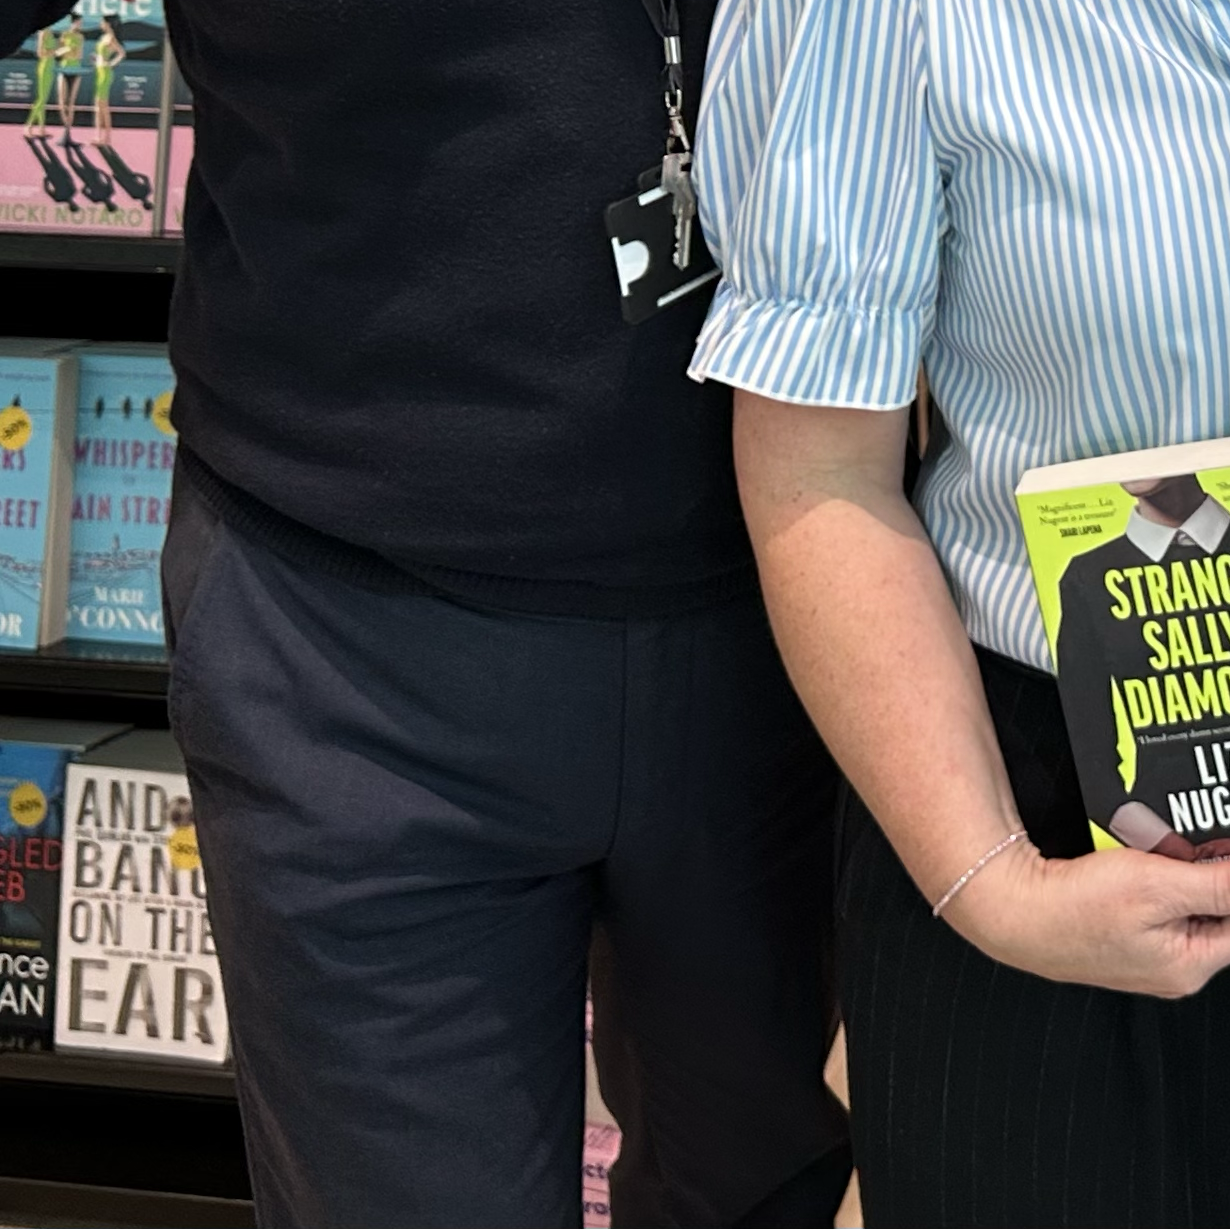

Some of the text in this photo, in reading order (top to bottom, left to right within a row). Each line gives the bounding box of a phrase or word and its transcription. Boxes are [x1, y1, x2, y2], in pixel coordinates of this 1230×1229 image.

[55, 206, 144, 228] NOTARO
[77, 776, 168, 832] AND
[70, 899, 217, 956] ON THE
[69, 956, 216, 1045] EAR
